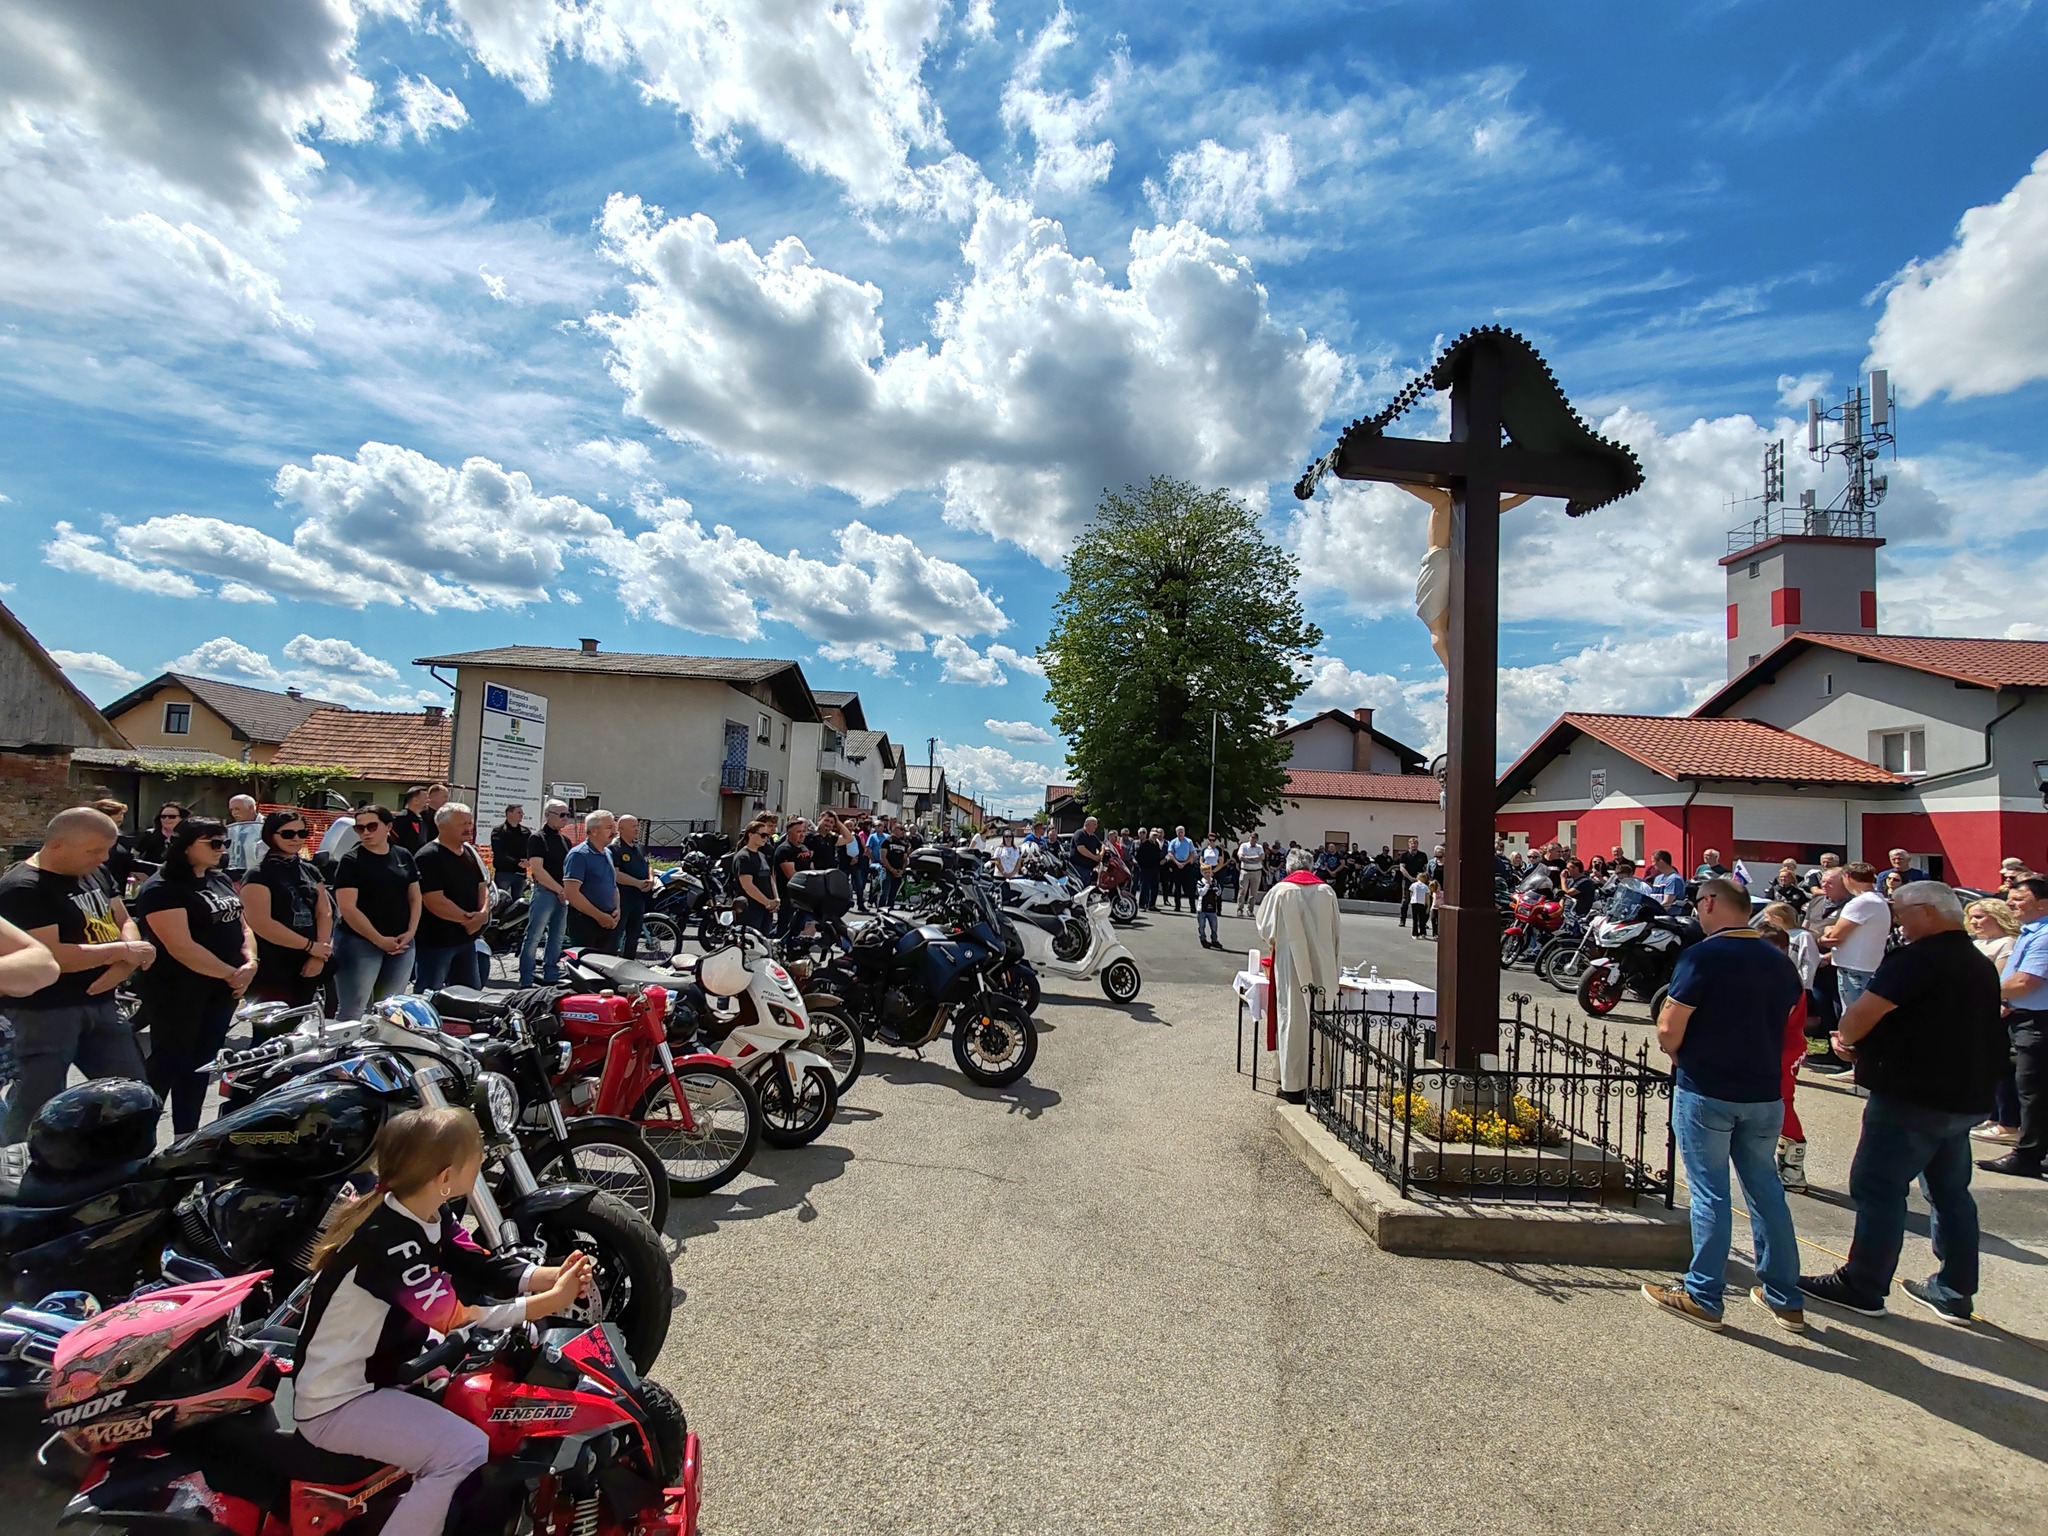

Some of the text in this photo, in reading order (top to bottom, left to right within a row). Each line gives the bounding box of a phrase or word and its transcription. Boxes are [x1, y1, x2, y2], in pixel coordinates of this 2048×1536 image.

[387, 1240, 450, 1311] FOX
[41, 1389, 128, 1427] THOR
[487, 1405, 577, 1422] RENEGADE
